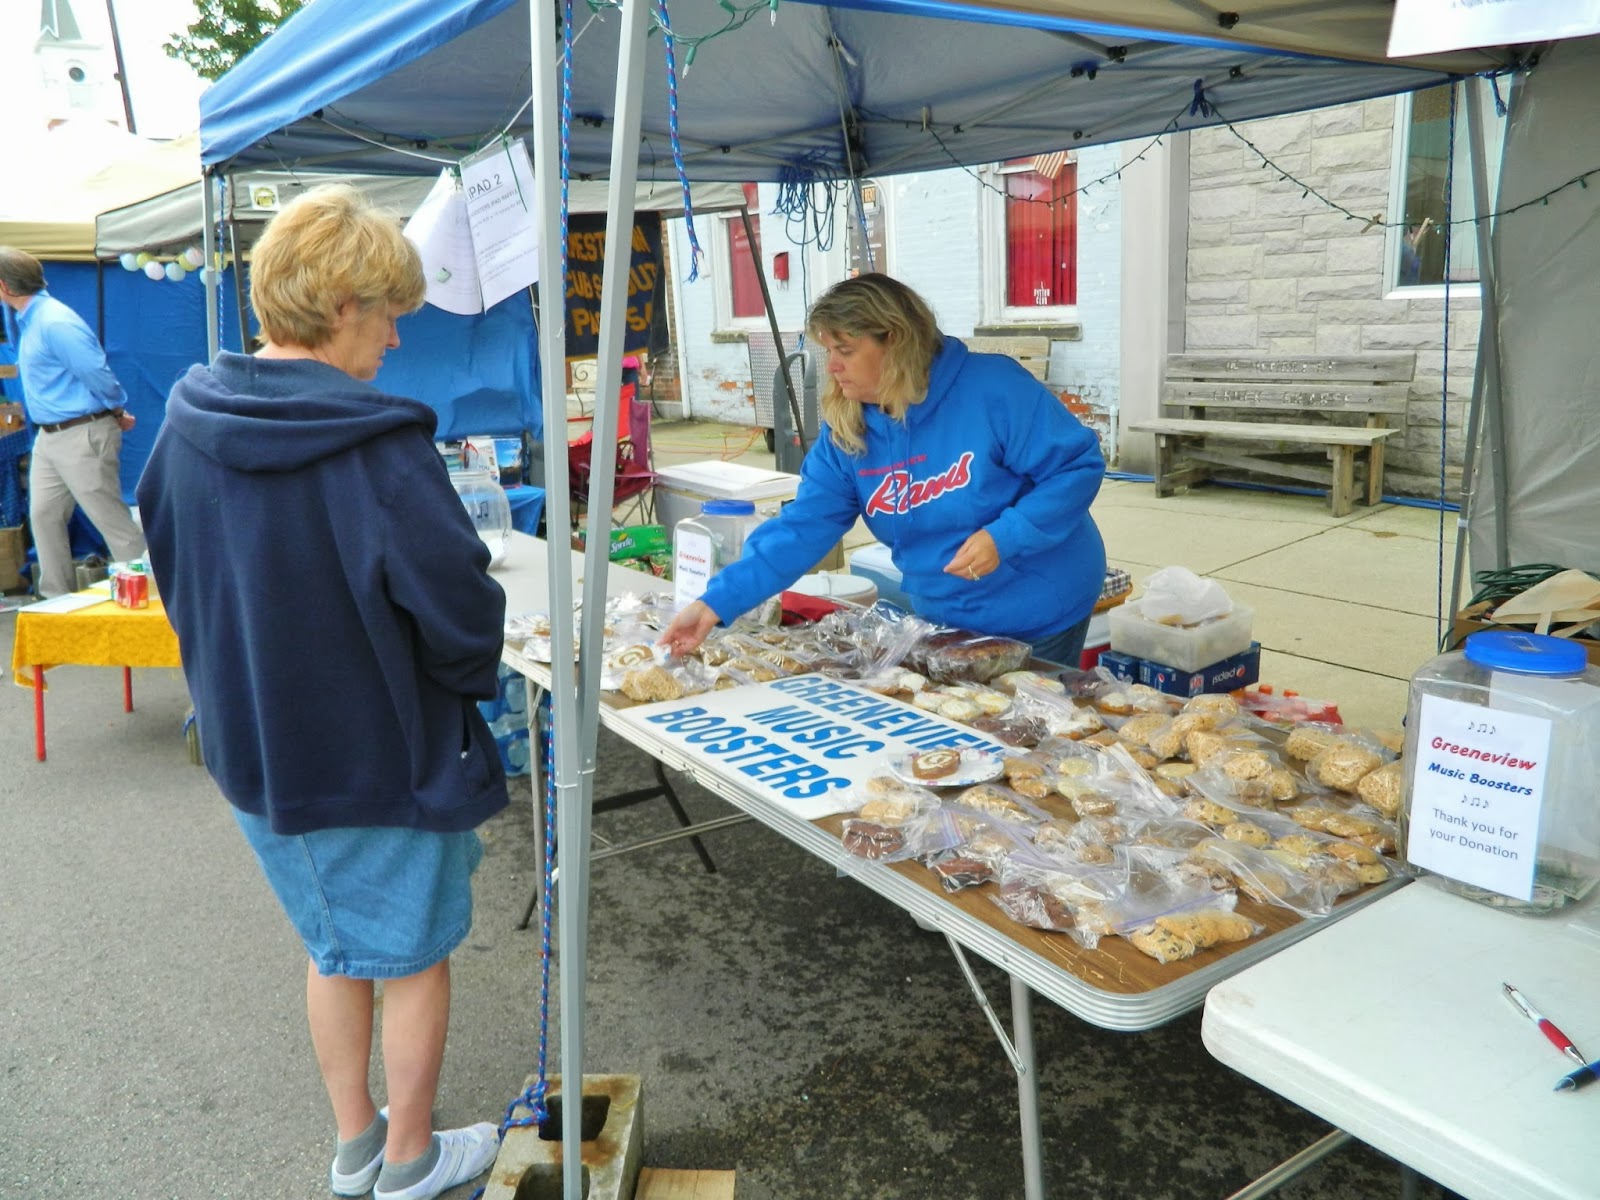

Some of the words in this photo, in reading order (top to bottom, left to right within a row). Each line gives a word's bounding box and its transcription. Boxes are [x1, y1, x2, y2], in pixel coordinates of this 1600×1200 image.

[494, 173, 503, 186] 2
[610, 538, 634, 554] Sprite
[1212, 667, 1236, 686] pepsi
[744, 704, 886, 760] MUSIC
[645, 706, 852, 799] BOOSTERS
[1431, 737, 1536, 770] Greeneview
[1428, 761, 1466, 780] Music
[1469, 772, 1533, 796] Boosters
[1433, 808, 1468, 828] Thank
[1471, 821, 1495, 836] you
[1499, 827, 1519, 840] for
[1429, 828, 1456, 844] your
[1459, 835, 1519, 860] Donation
